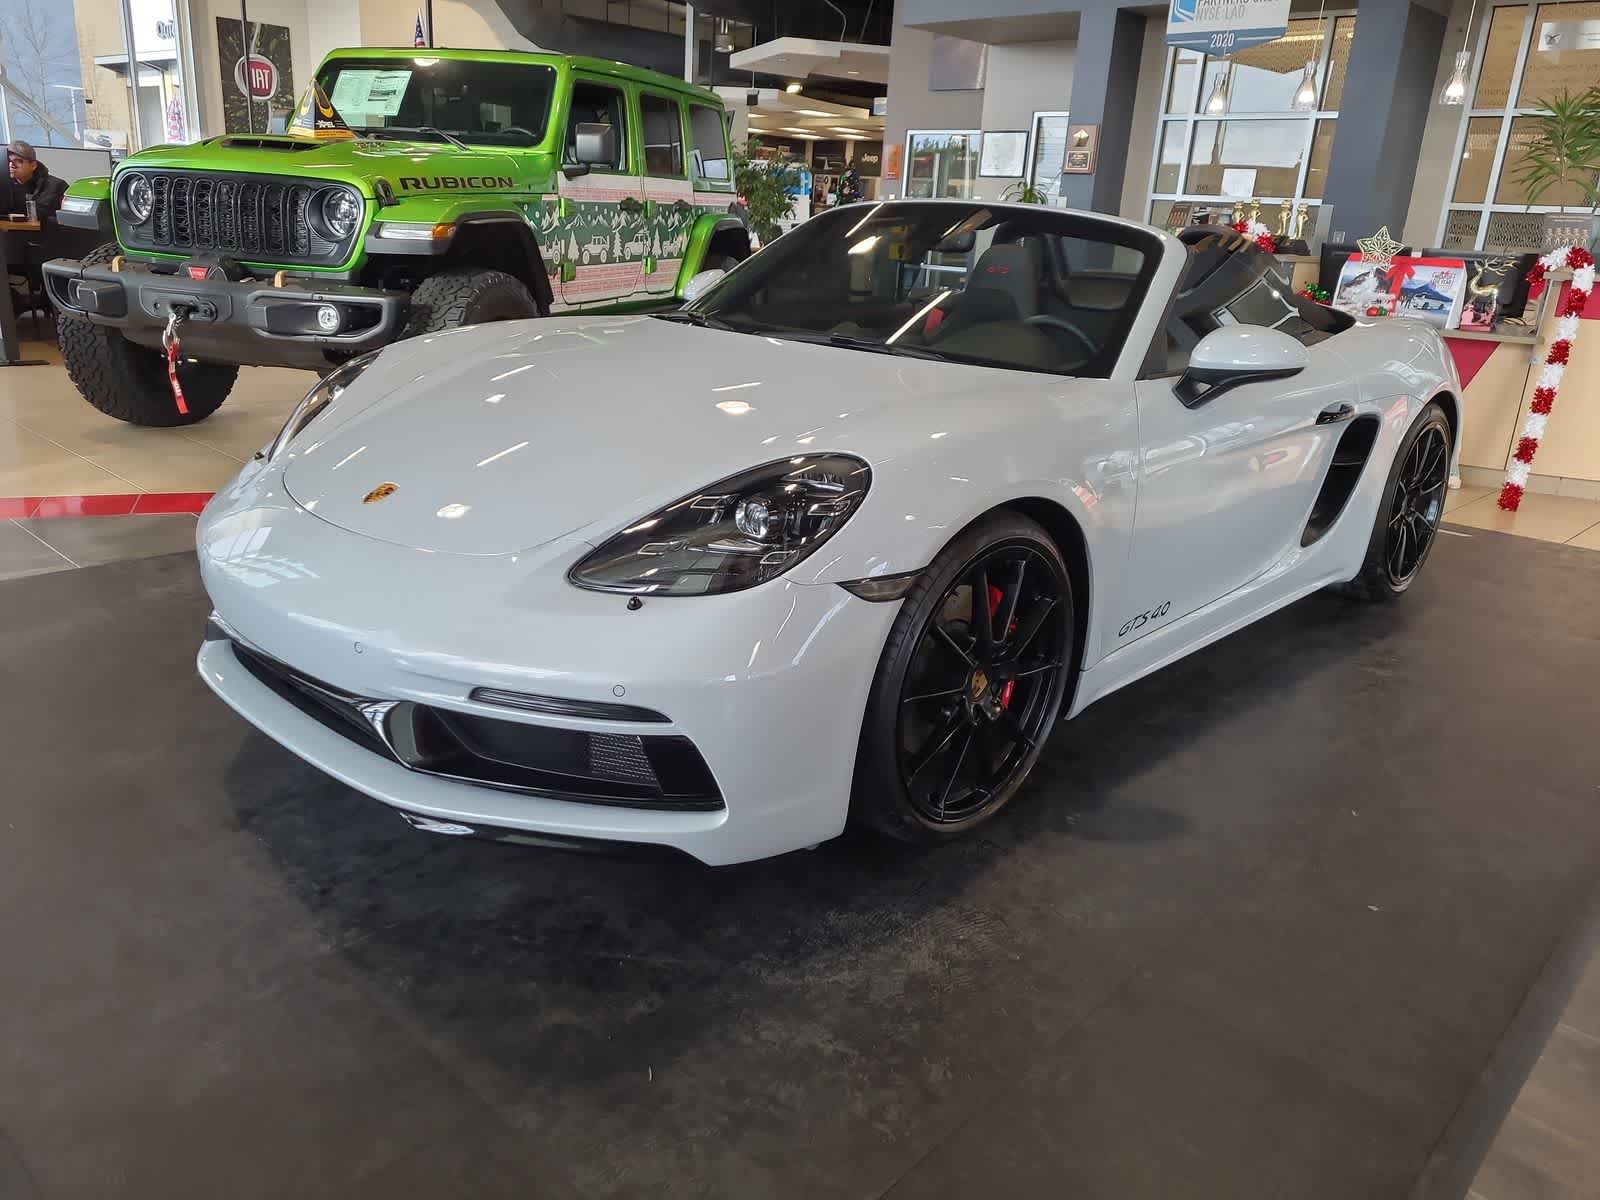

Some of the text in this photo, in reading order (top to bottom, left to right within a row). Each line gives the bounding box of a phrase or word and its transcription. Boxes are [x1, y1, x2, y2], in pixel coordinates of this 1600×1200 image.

[1210, 32, 1235, 48] 2020
[251, 68, 270, 90] IAT
[861, 153, 879, 164] Jeep
[399, 176, 513, 190] RUBICON
[1118, 610, 1151, 637] GTS
